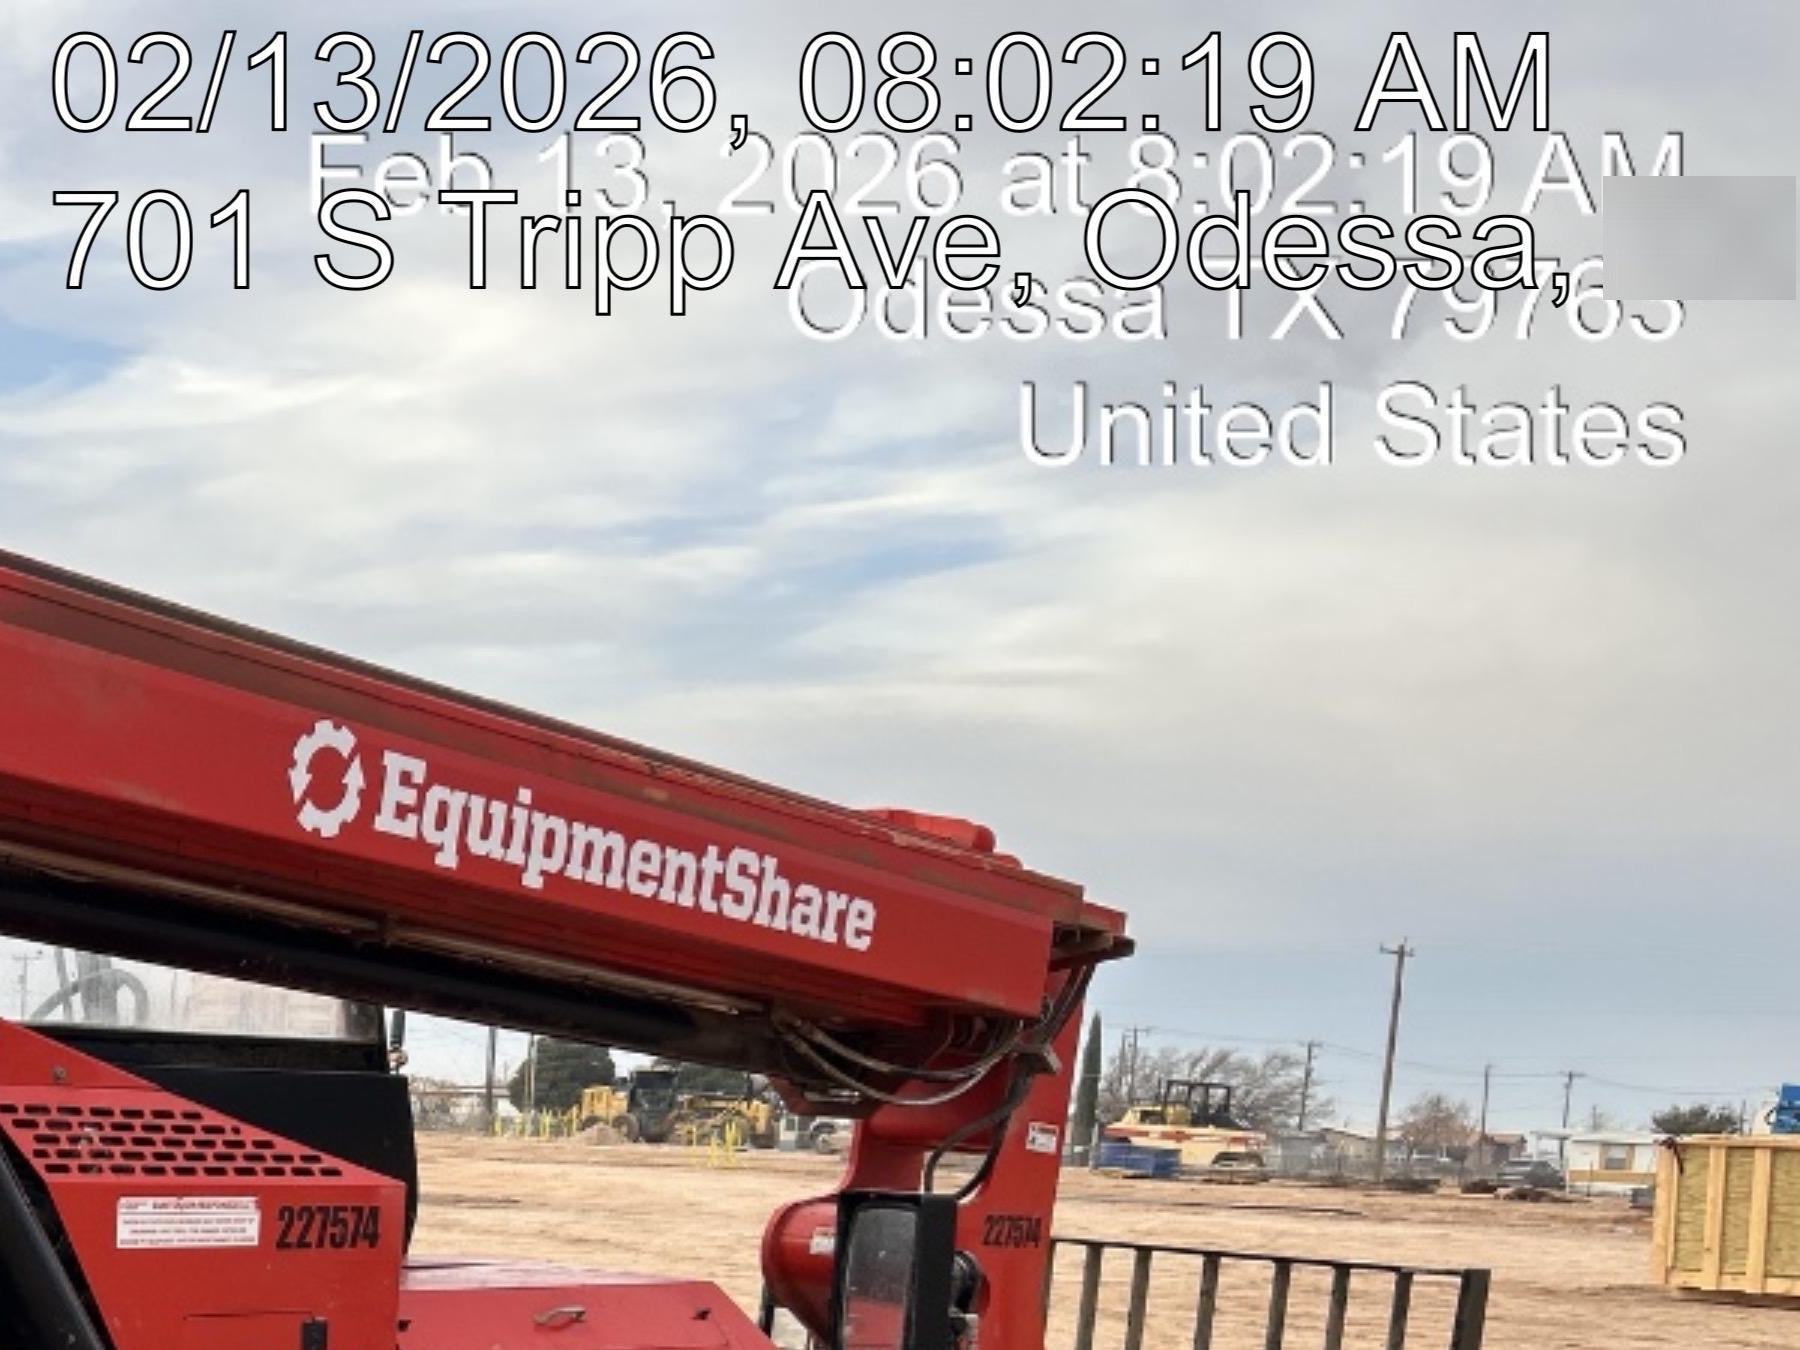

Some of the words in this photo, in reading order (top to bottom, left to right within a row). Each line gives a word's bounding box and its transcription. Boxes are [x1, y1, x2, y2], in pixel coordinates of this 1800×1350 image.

[374, 749, 878, 952] EquipmentShare
[275, 1205, 380, 1250] 227574
[983, 1215, 1041, 1248] 227574
